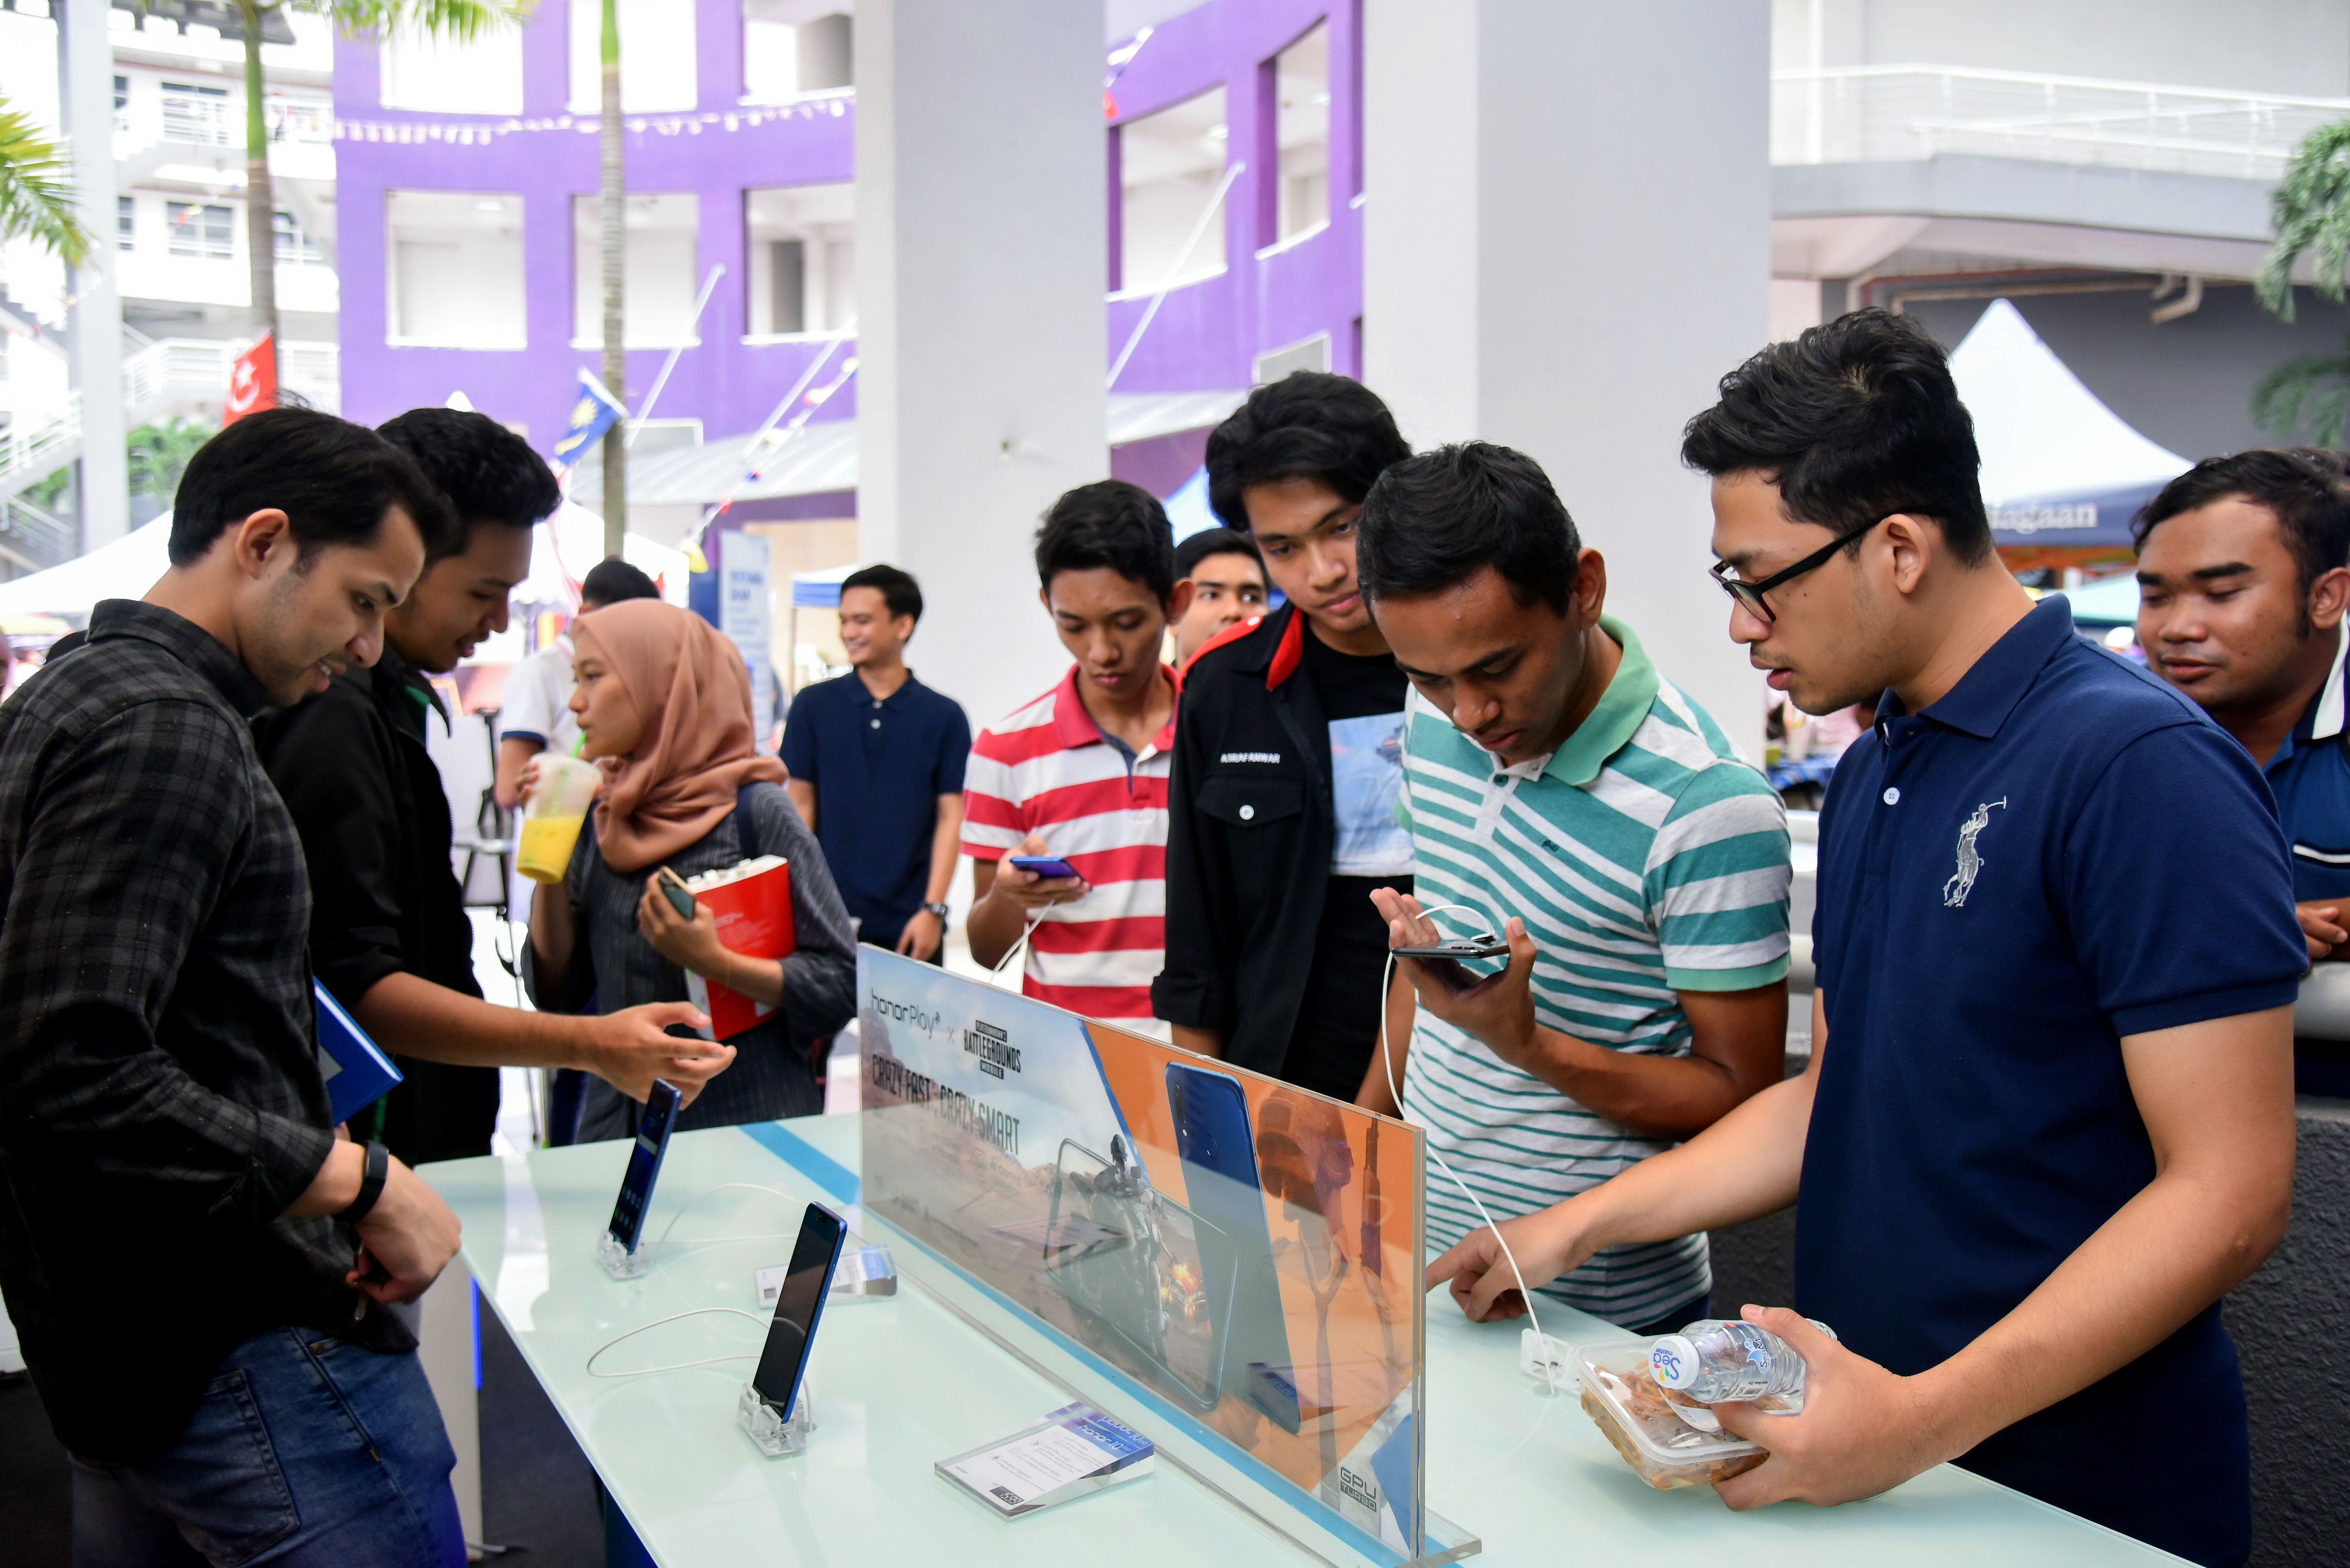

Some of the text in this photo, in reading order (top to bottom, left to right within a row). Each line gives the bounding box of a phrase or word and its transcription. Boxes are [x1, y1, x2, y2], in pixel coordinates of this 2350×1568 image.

[872, 988, 908, 1022] honor
[964, 1029, 1021, 1073] BATTLEGROUNDS
[872, 1054, 904, 1098] CRAZY
[940, 1085, 975, 1132] CRAZY
[979, 1102, 1020, 1155] SMART
[1653, 1353, 1681, 1380] Sea
[1078, 1424, 1111, 1442] honor
[1109, 1441, 1124, 1450] 10
[1340, 1466, 1376, 1499] GPU
[1341, 1483, 1376, 1510] TURBO
